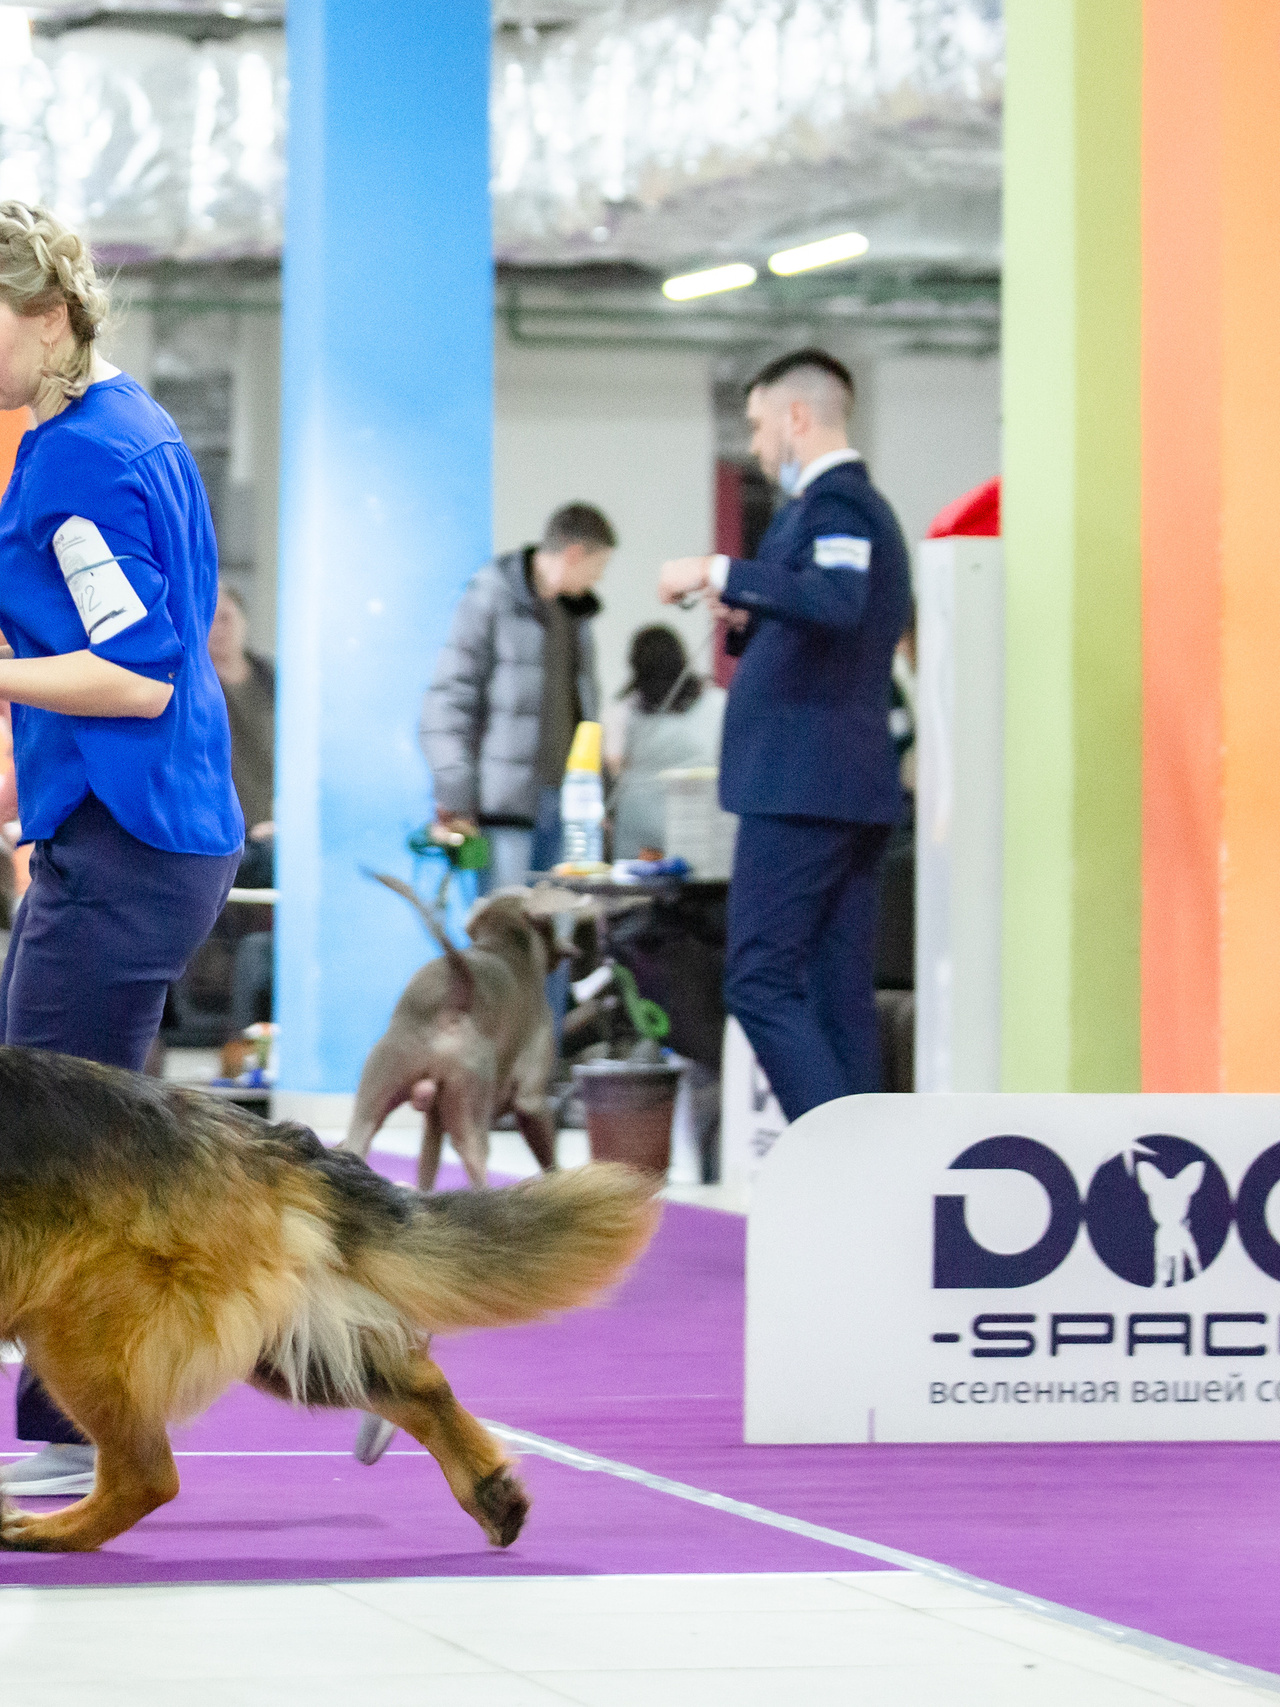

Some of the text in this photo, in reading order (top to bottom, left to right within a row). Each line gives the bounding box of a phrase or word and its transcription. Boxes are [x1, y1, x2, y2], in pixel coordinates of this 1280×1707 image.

[932, 1133, 1280, 1289] DO
[931, 1312, 1280, 1358] -SPAC
[929, 1380, 1119, 1404] вселенная
[1131, 1372, 1245, 1403] вашей
